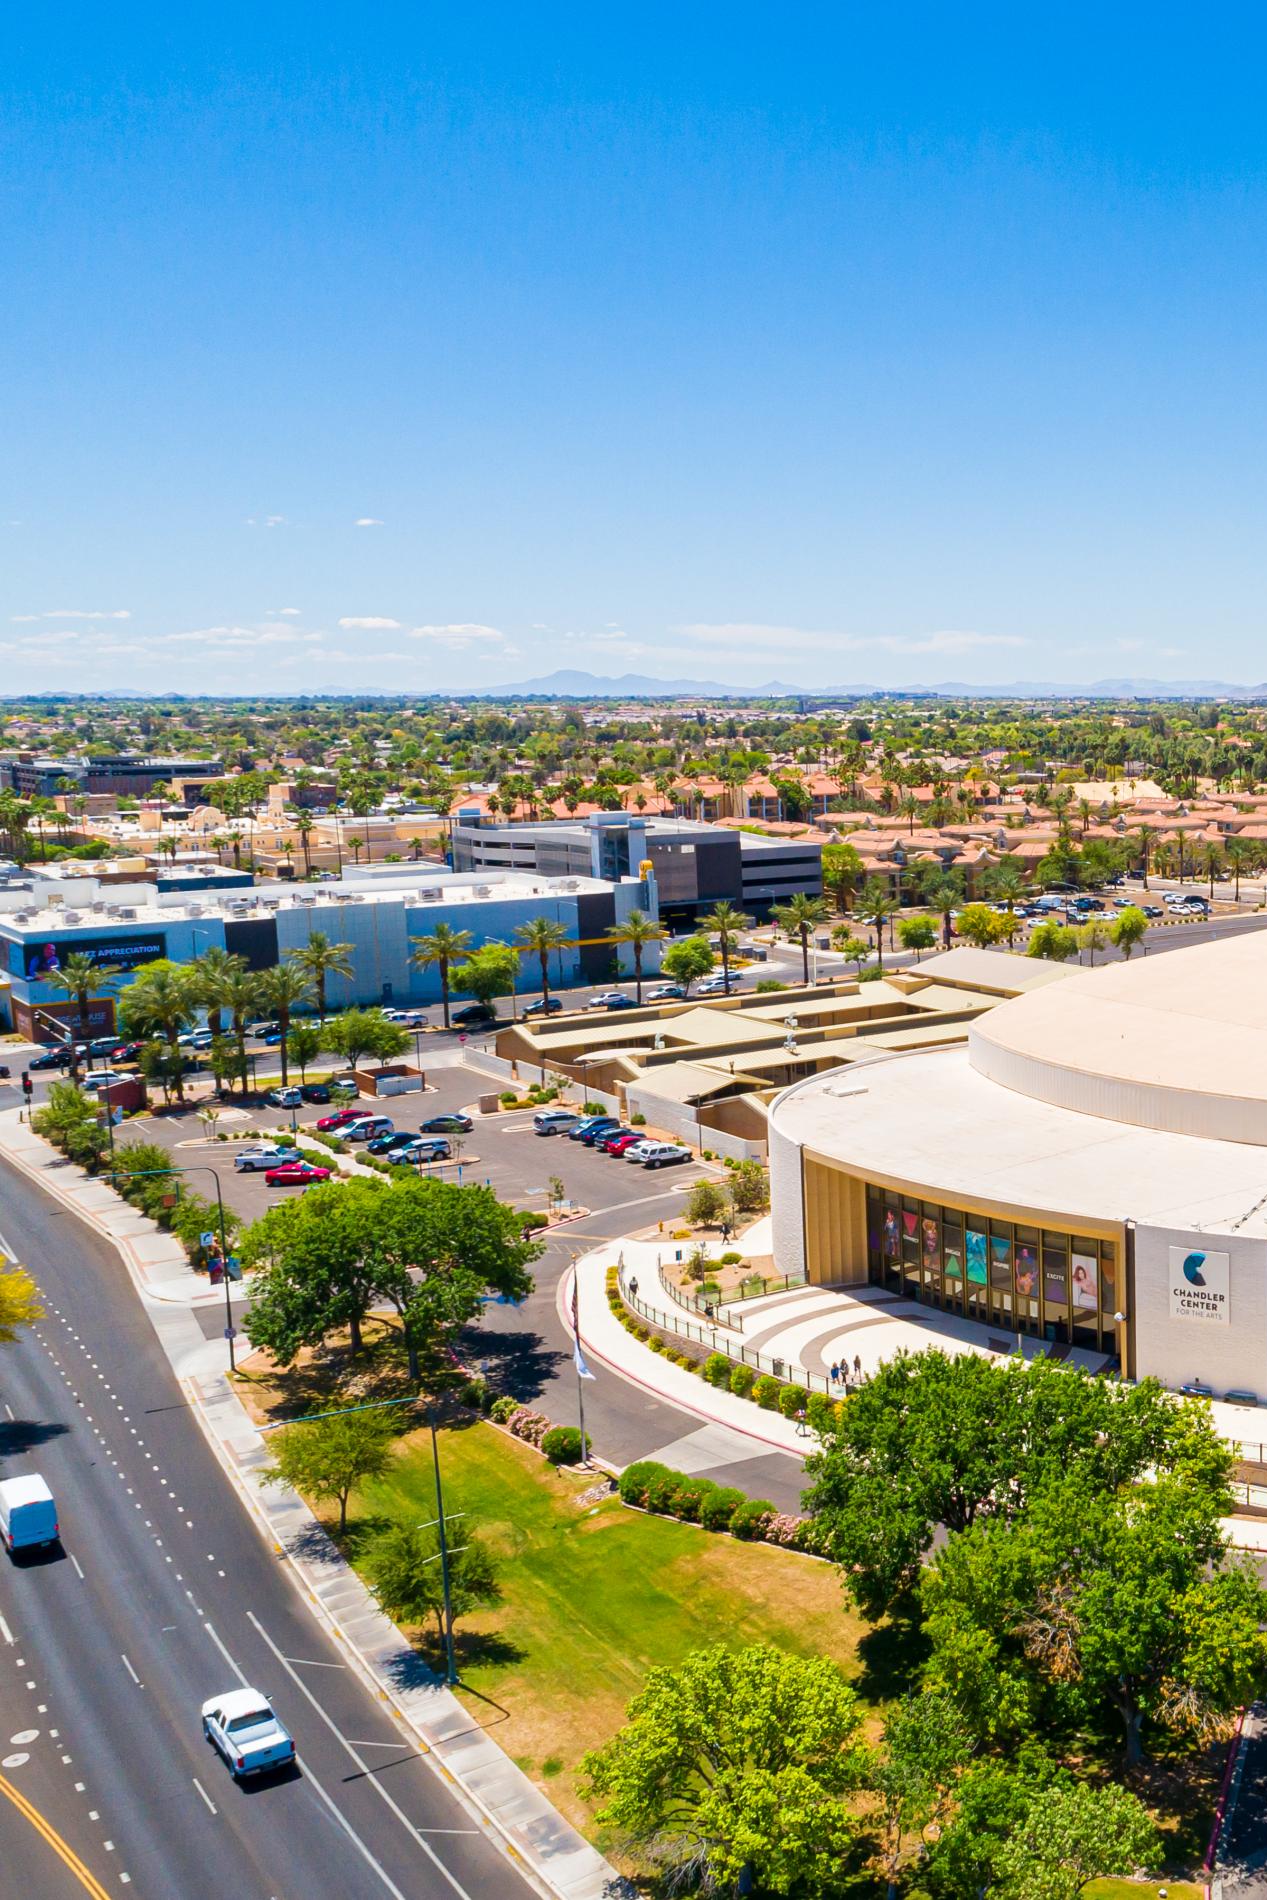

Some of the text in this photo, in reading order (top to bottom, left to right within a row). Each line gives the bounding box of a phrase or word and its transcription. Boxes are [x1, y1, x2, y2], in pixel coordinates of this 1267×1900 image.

[98, 945, 160, 957] APPRECIATION
[1173, 1288, 1225, 1302] CHANDLER
[1181, 1299, 1218, 1311] CENTER
[1176, 1308, 1223, 1321] FOR THE ARTS
